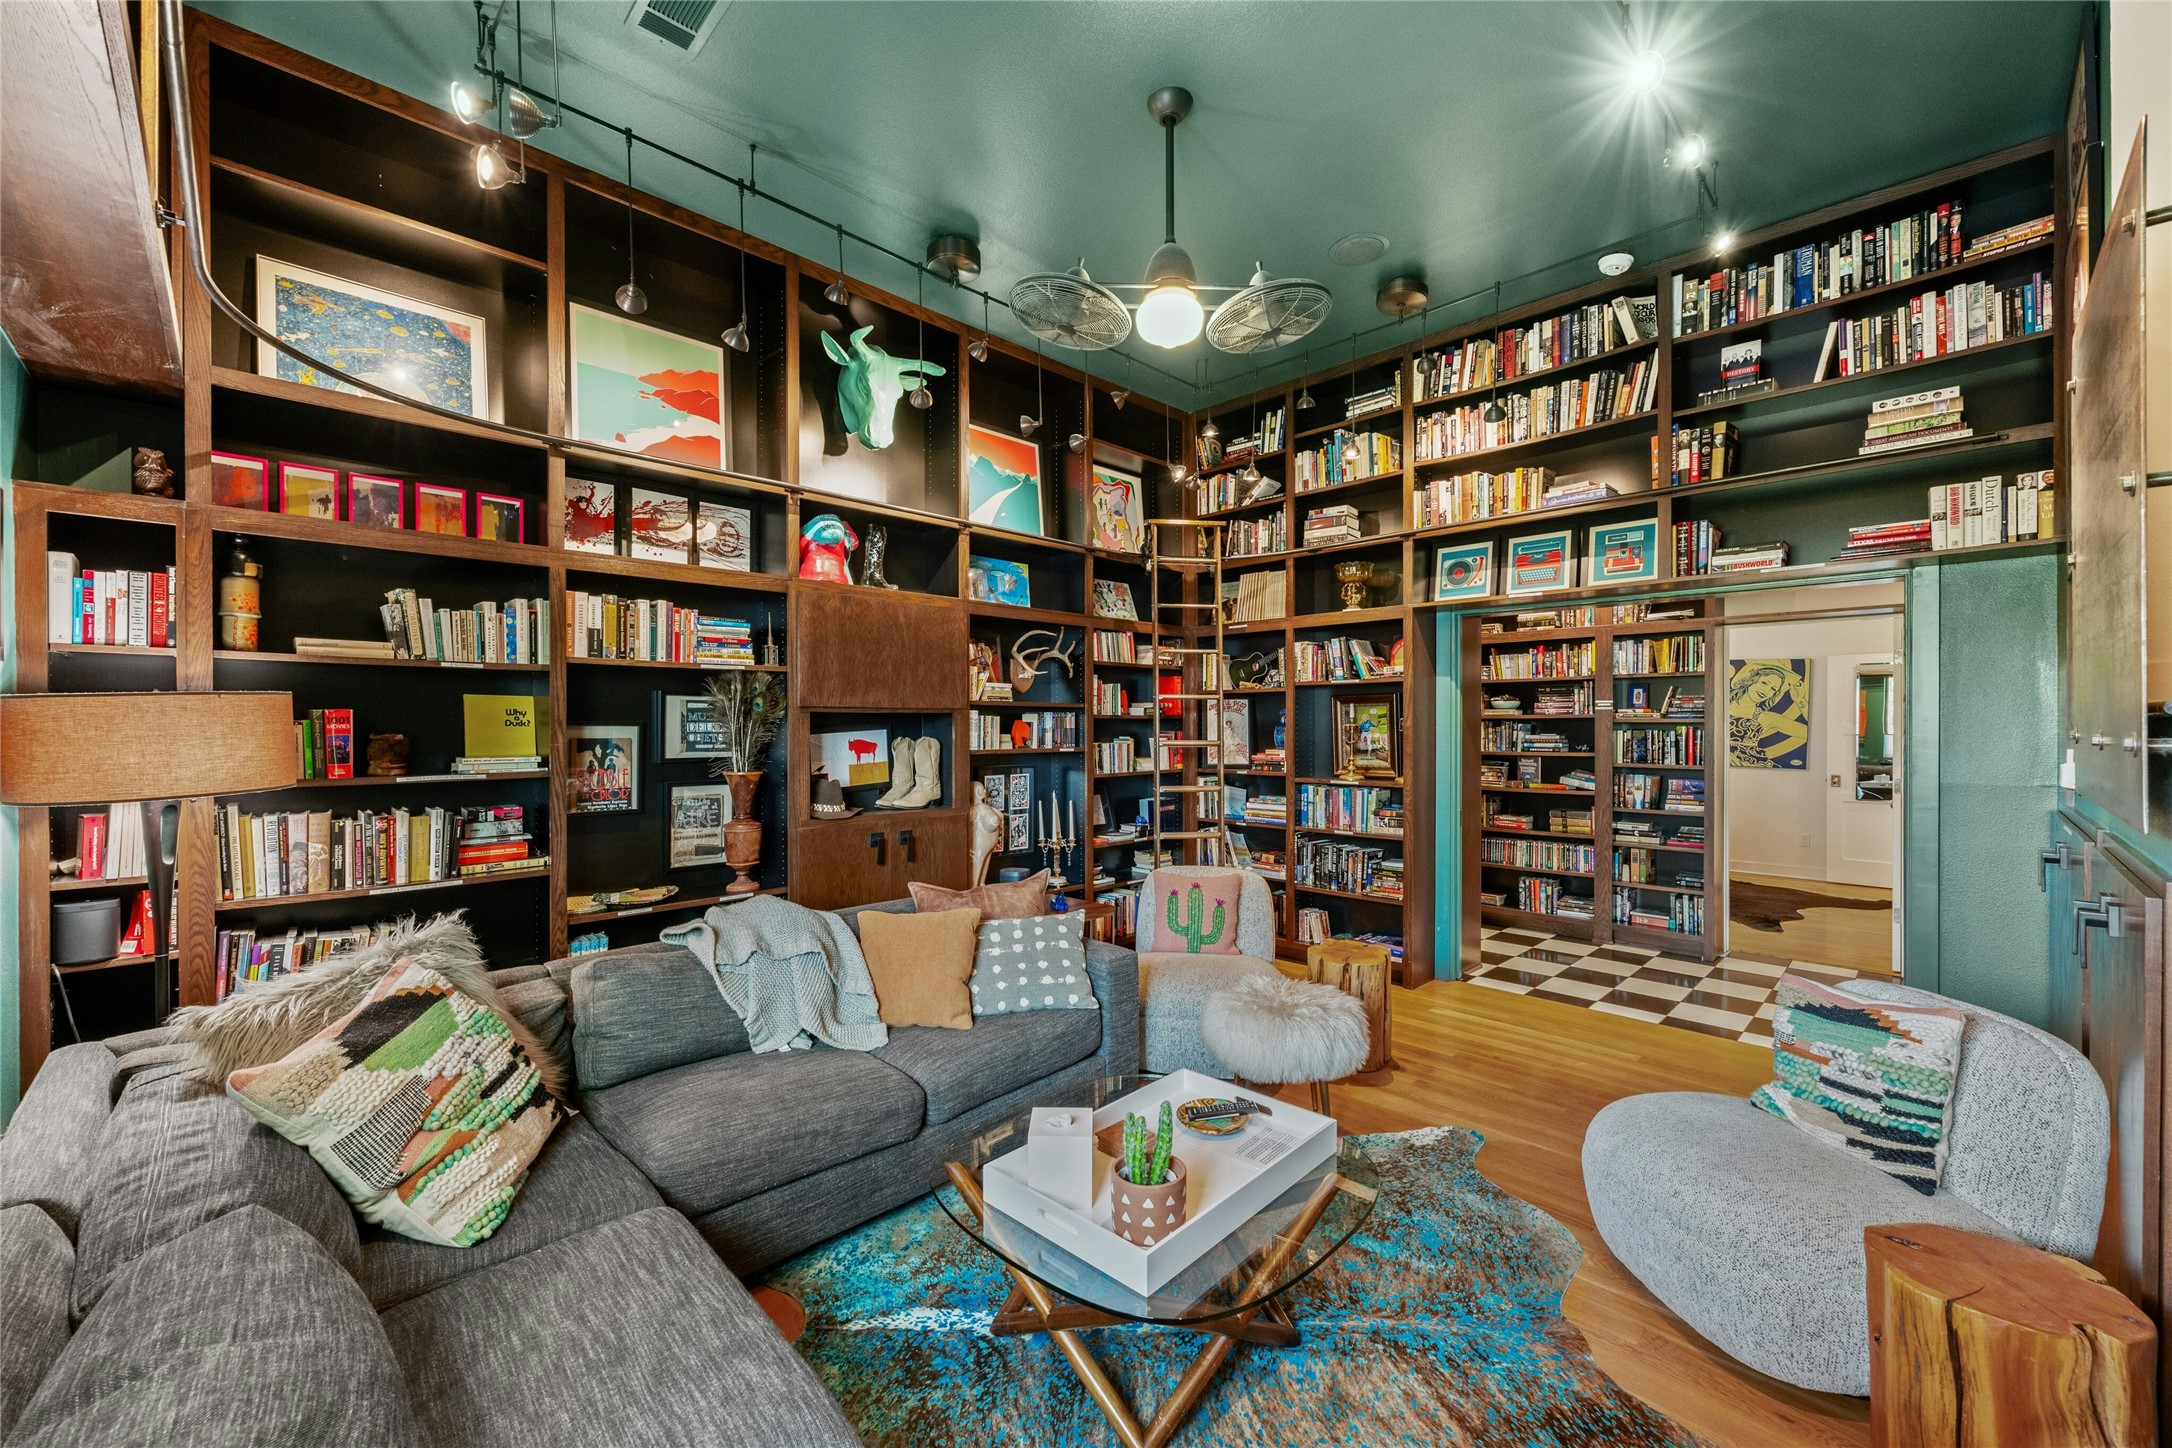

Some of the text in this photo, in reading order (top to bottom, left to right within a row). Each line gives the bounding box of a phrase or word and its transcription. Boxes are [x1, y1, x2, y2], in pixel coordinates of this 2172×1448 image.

[1802, 246, 1813, 276] TRUMAN
[1886, 407, 1914, 415] UNITED
[1917, 426, 1954, 437] DOCUMENTS
[1986, 479, 1998, 512] Dutch
[1950, 487, 1960, 526] BOB WOODWARD
[1733, 560, 1773, 570] BUSHWORLD
[154, 574, 165, 601] HUNTER
[505, 708, 526, 718] Why
